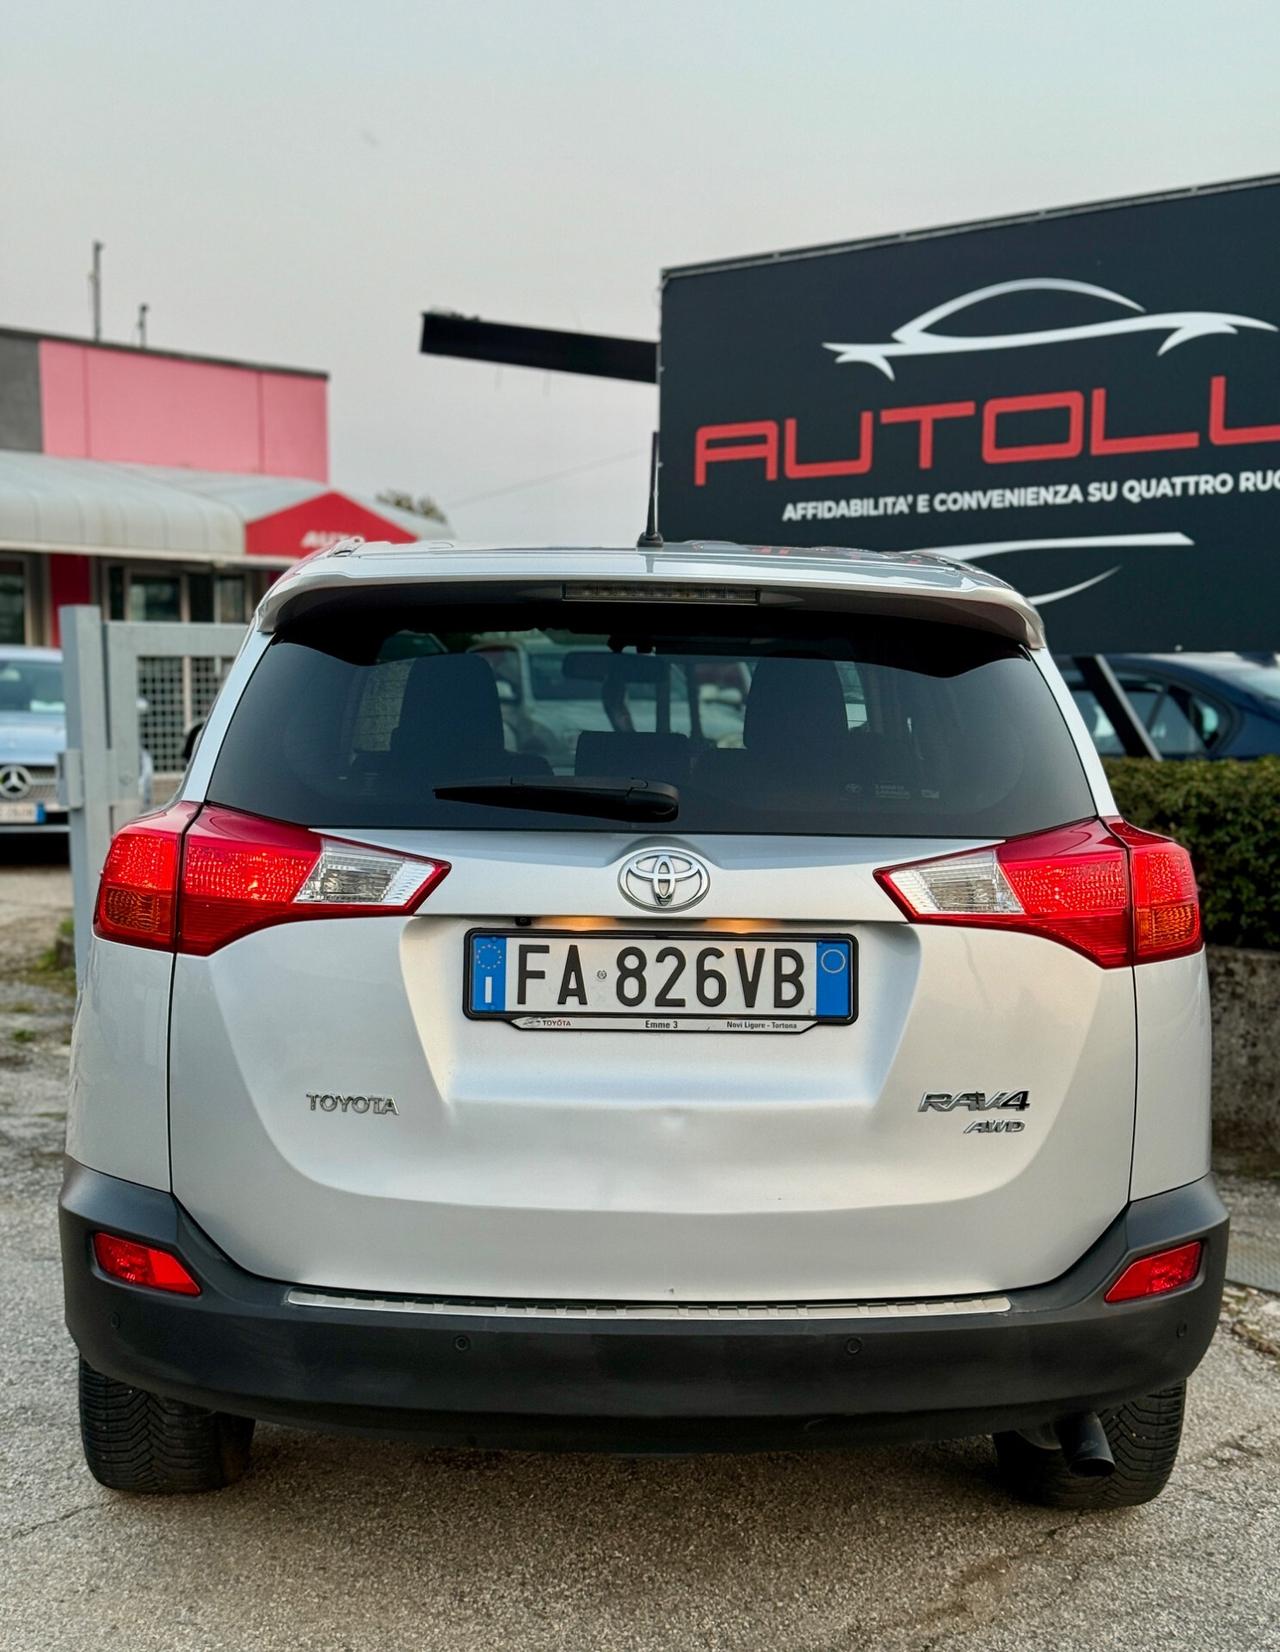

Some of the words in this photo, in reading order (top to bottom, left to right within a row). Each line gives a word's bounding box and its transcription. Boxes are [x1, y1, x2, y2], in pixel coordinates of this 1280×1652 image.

[782, 494, 913, 522] AFFIDABILITA'
[916, 495, 929, 513] E
[933, 484, 1084, 512] CONVENIENZA
[1087, 481, 1118, 502] SU
[1122, 472, 1234, 503] QUATTRO
[517, 944, 588, 1005] FA
[616, 946, 804, 1009] 826VB
[543, 1019, 571, 1027] TOYOTA
[645, 1020, 671, 1029] Emme
[673, 1020, 678, 1029] 3
[727, 1021, 743, 1029] Novi
[306, 1093, 400, 1116] TOYOTA
[917, 1091, 1031, 1112] RAV4
[963, 1119, 1026, 1134] AWD
